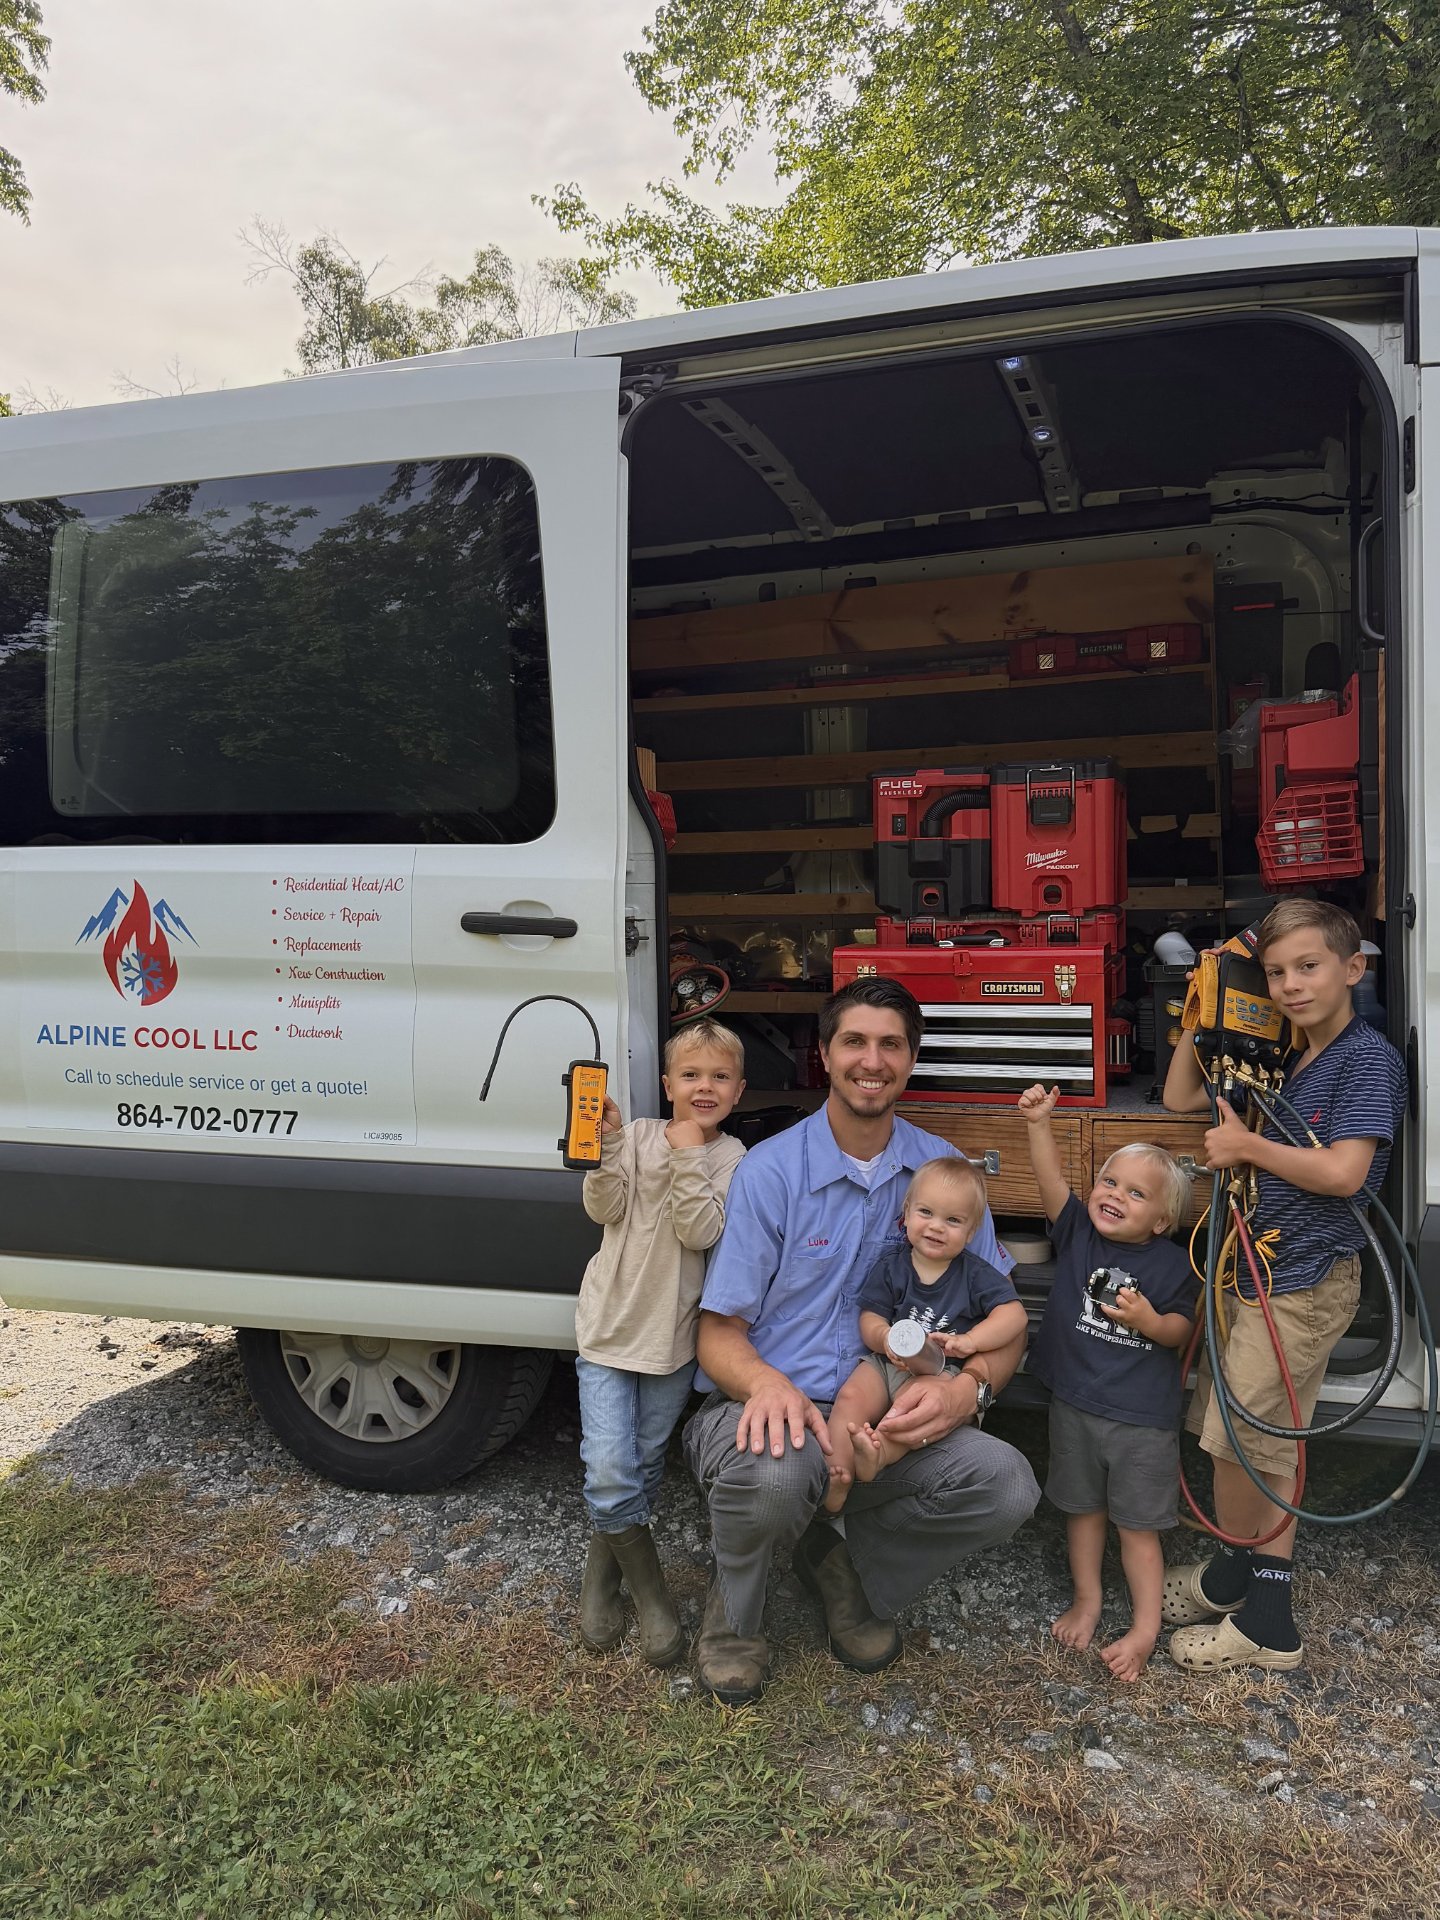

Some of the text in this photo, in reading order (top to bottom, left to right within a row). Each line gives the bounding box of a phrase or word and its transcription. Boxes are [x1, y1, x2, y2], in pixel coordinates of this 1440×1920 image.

[1080, 643, 1123, 654] CRAFTSMAN
[880, 780, 923, 789] FUEL
[1023, 848, 1068, 866] Milwaukee
[283, 875, 405, 894] Residential Heat/AC
[283, 906, 327, 921] Service
[339, 906, 382, 928] Repair
[283, 936, 363, 957] Replacements
[288, 965, 386, 981] New Construction
[984, 983, 1041, 993] CRAFTSMAN
[288, 993, 343, 1015] Minisplits
[36, 1023, 258, 1051] ALPINE COOL LLC
[286, 1023, 343, 1041] Ductwork
[64, 1068, 368, 1098] Call to schedule service or get a quote!
[116, 1102, 299, 1135] 864-702-0777
[363, 1131, 403, 1141] LIC#39085
[807, 1237, 829, 1247] Luke
[1075, 1321, 1091, 1334] LAKE
[1090, 1327, 1140, 1348] WINNIPESAUKEE
[1252, 1567, 1292, 1582] VANS
